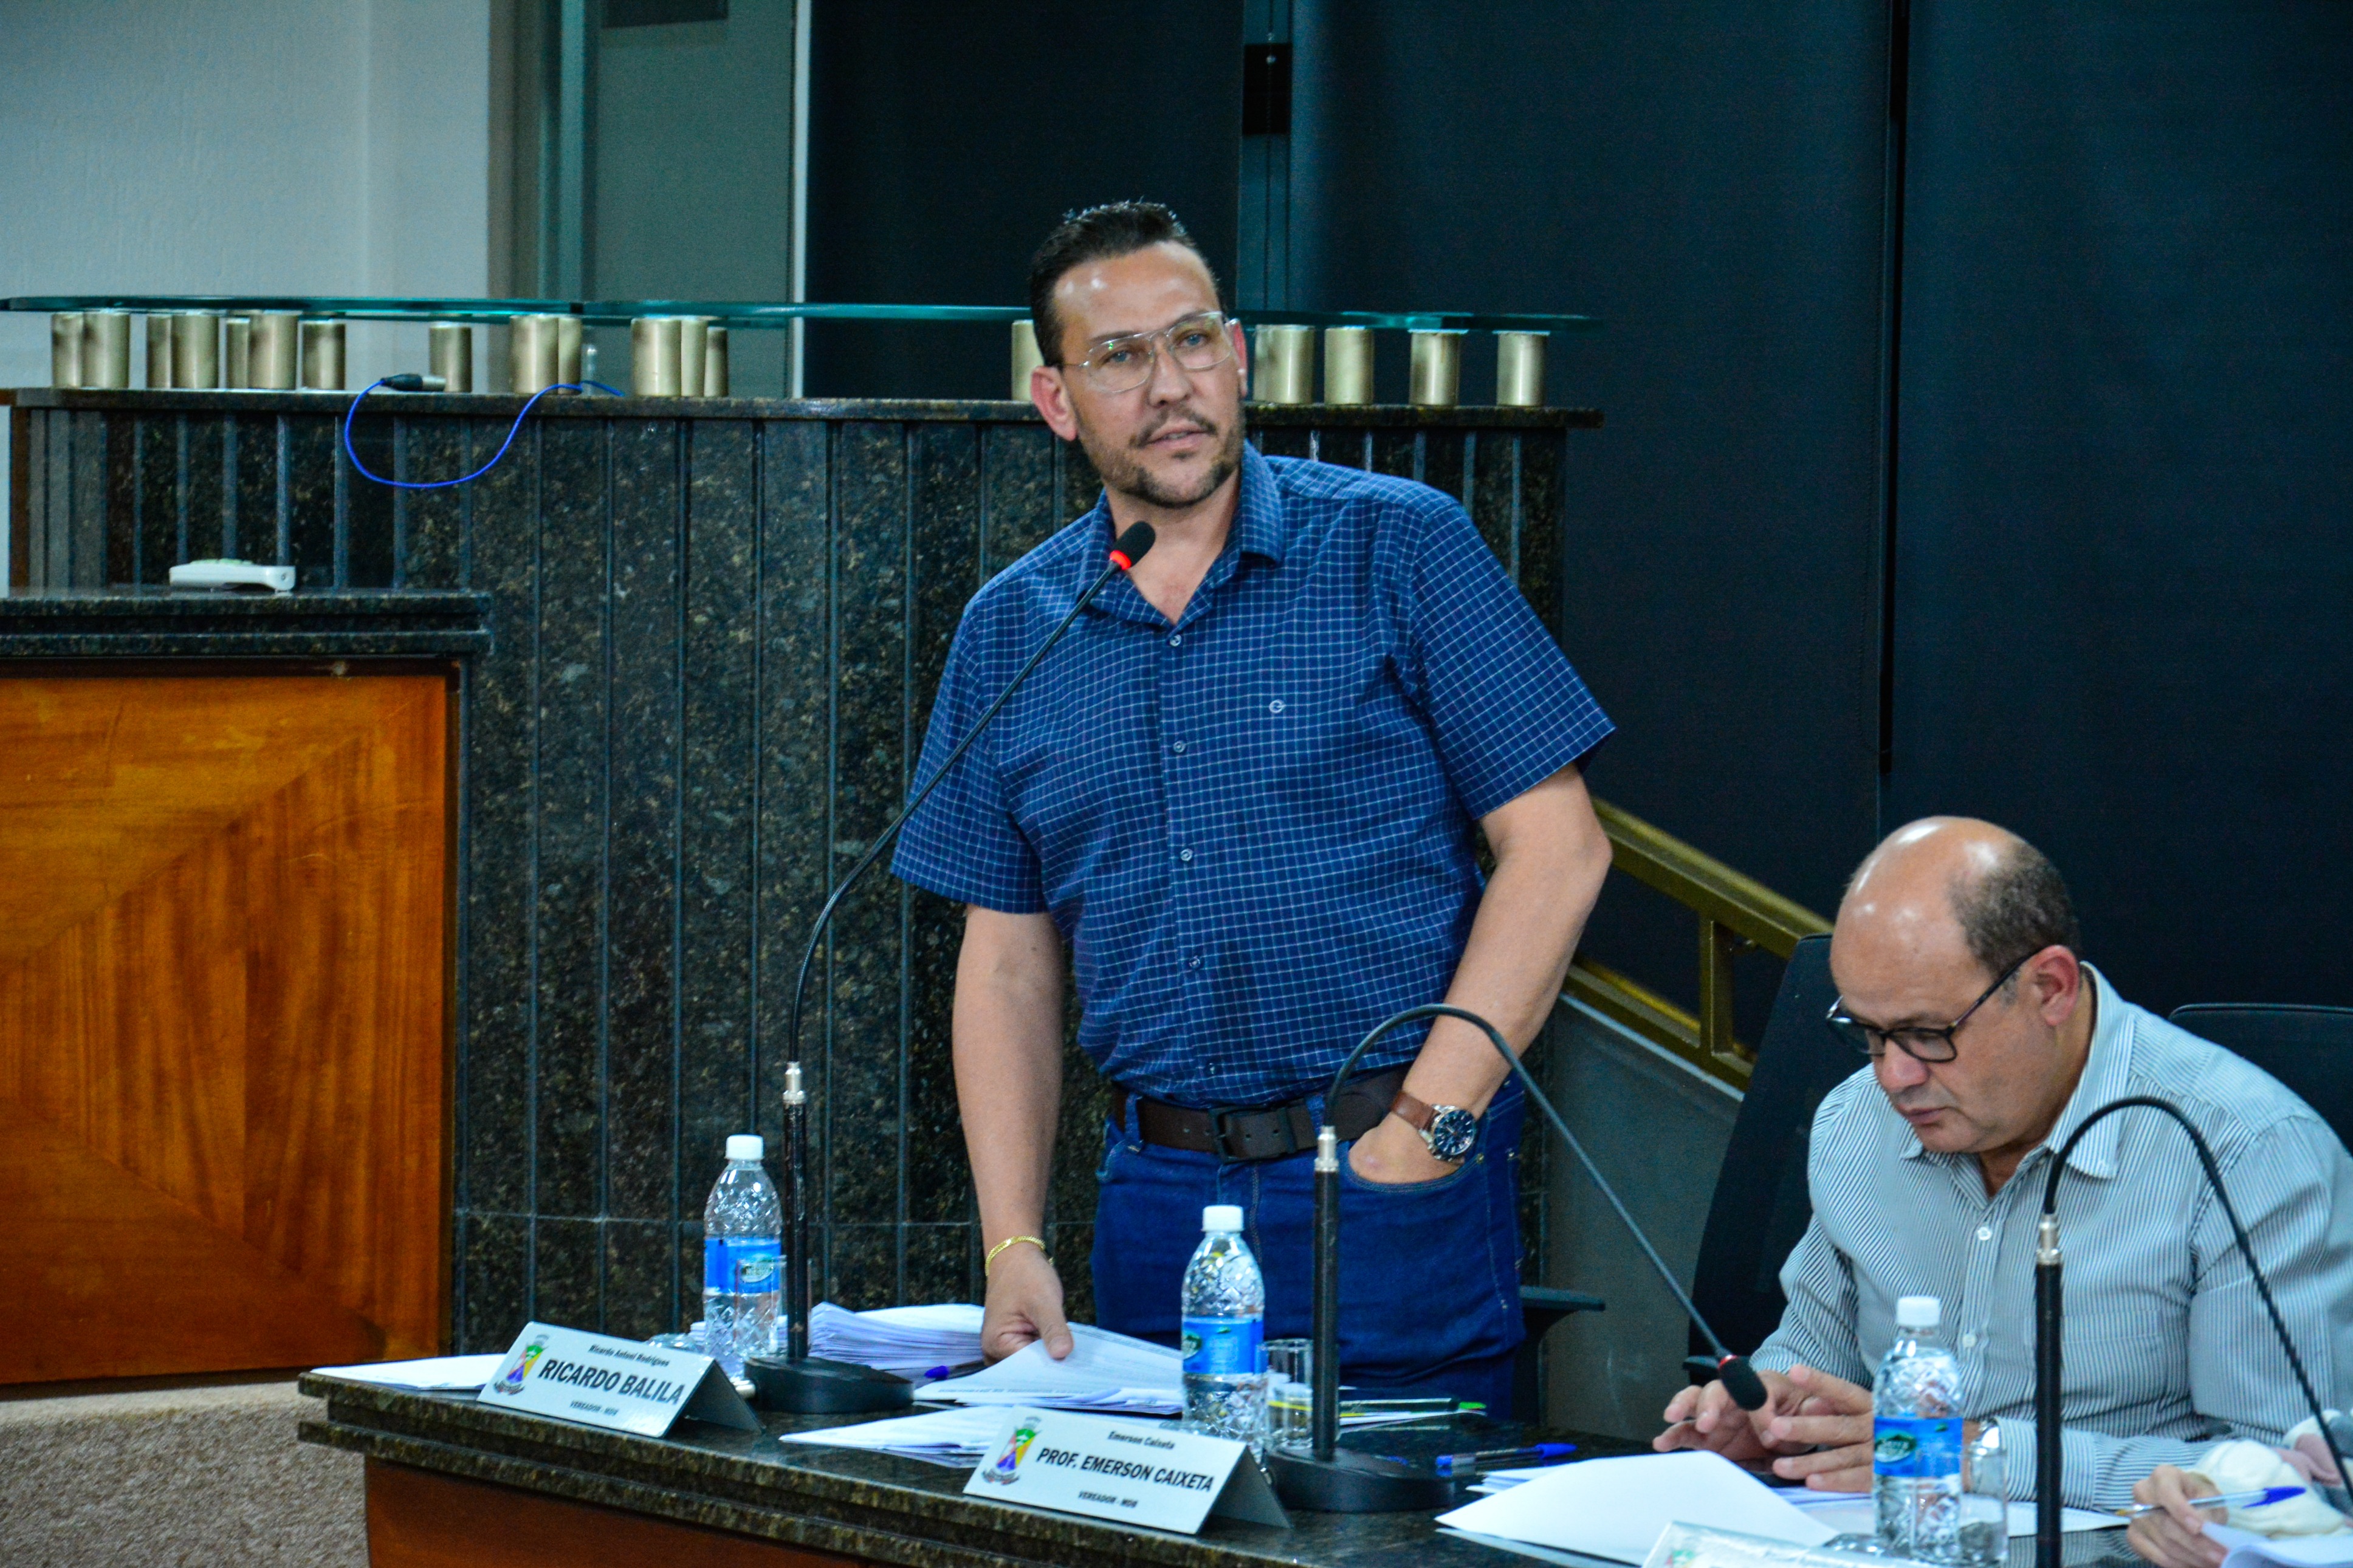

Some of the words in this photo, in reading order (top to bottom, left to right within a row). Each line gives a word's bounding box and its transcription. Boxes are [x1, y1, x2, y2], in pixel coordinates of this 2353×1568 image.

[589, 1343, 614, 1356] Ricardo
[636, 1353, 670, 1367] Rodrigues
[538, 1358, 621, 1391] RICARDO
[617, 1374, 685, 1405] BALILA
[570, 1400, 602, 1413] VEREADOR
[1108, 1431, 1142, 1444] Emerson
[1144, 1436, 1175, 1450] Caixeta
[1036, 1448, 1079, 1468] PROF.
[1080, 1455, 1153, 1481] EMERSON
[1153, 1467, 1214, 1492] CAIXETA
[1078, 1491, 1118, 1504] VEREADOR
[1121, 1498, 1139, 1508] MDB
